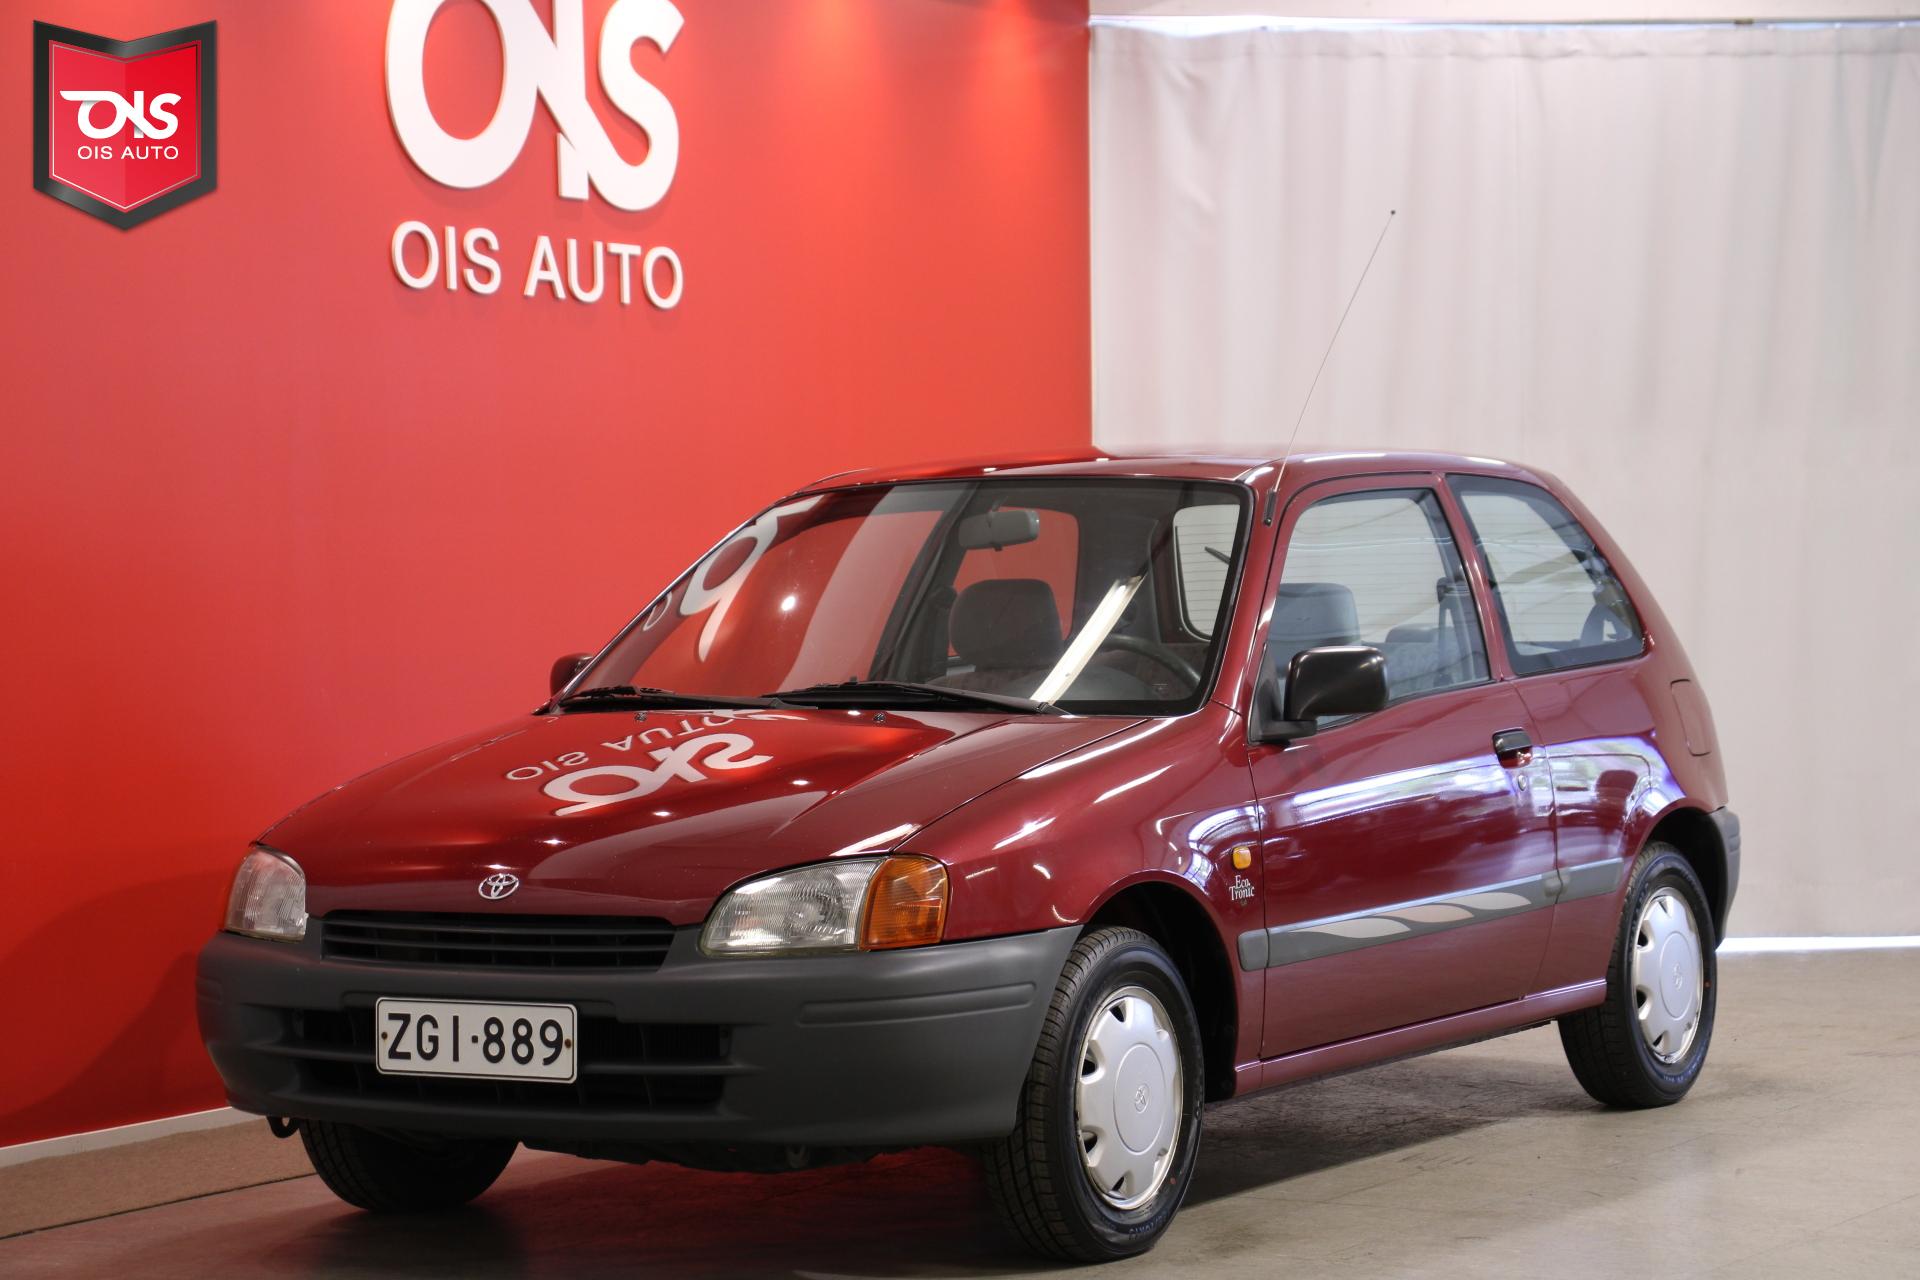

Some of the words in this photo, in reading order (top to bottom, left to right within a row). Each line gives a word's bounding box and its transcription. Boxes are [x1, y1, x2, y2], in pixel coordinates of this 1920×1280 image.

[392, 221, 501, 295] OIS
[524, 235, 683, 309] AUTO
[1229, 883, 1255, 901] Tronic
